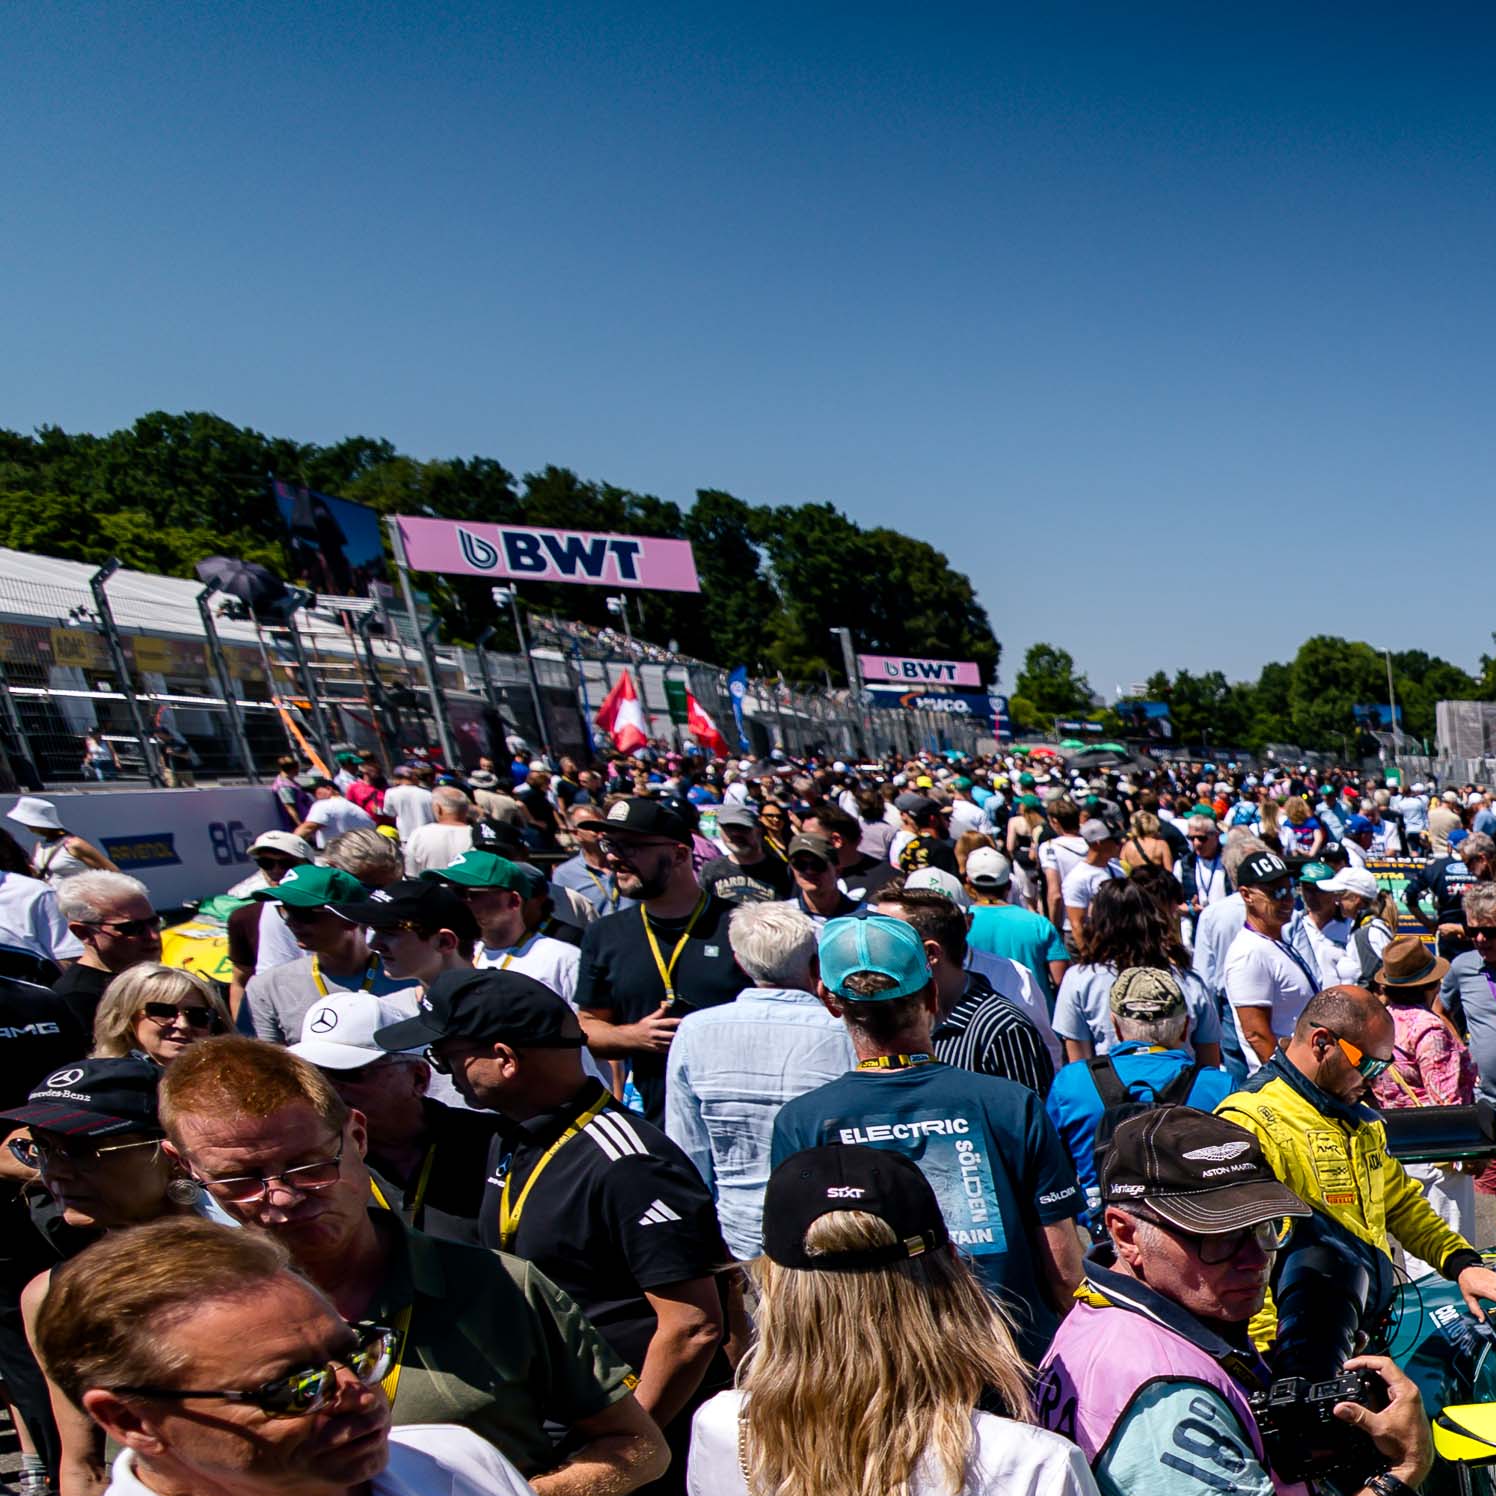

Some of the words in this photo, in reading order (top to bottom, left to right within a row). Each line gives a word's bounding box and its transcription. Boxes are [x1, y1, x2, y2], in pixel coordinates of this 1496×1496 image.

[501, 529, 643, 581] BWT
[902, 661, 956, 681] BWT
[840, 1118, 969, 1145] ELECTRIC
[955, 1139, 988, 1224] SÖLDEN
[1202, 1166, 1229, 1178] ASTON
[1039, 1186, 1076, 1206] SÖLDEN
[1111, 1184, 1146, 1196] Vantage
